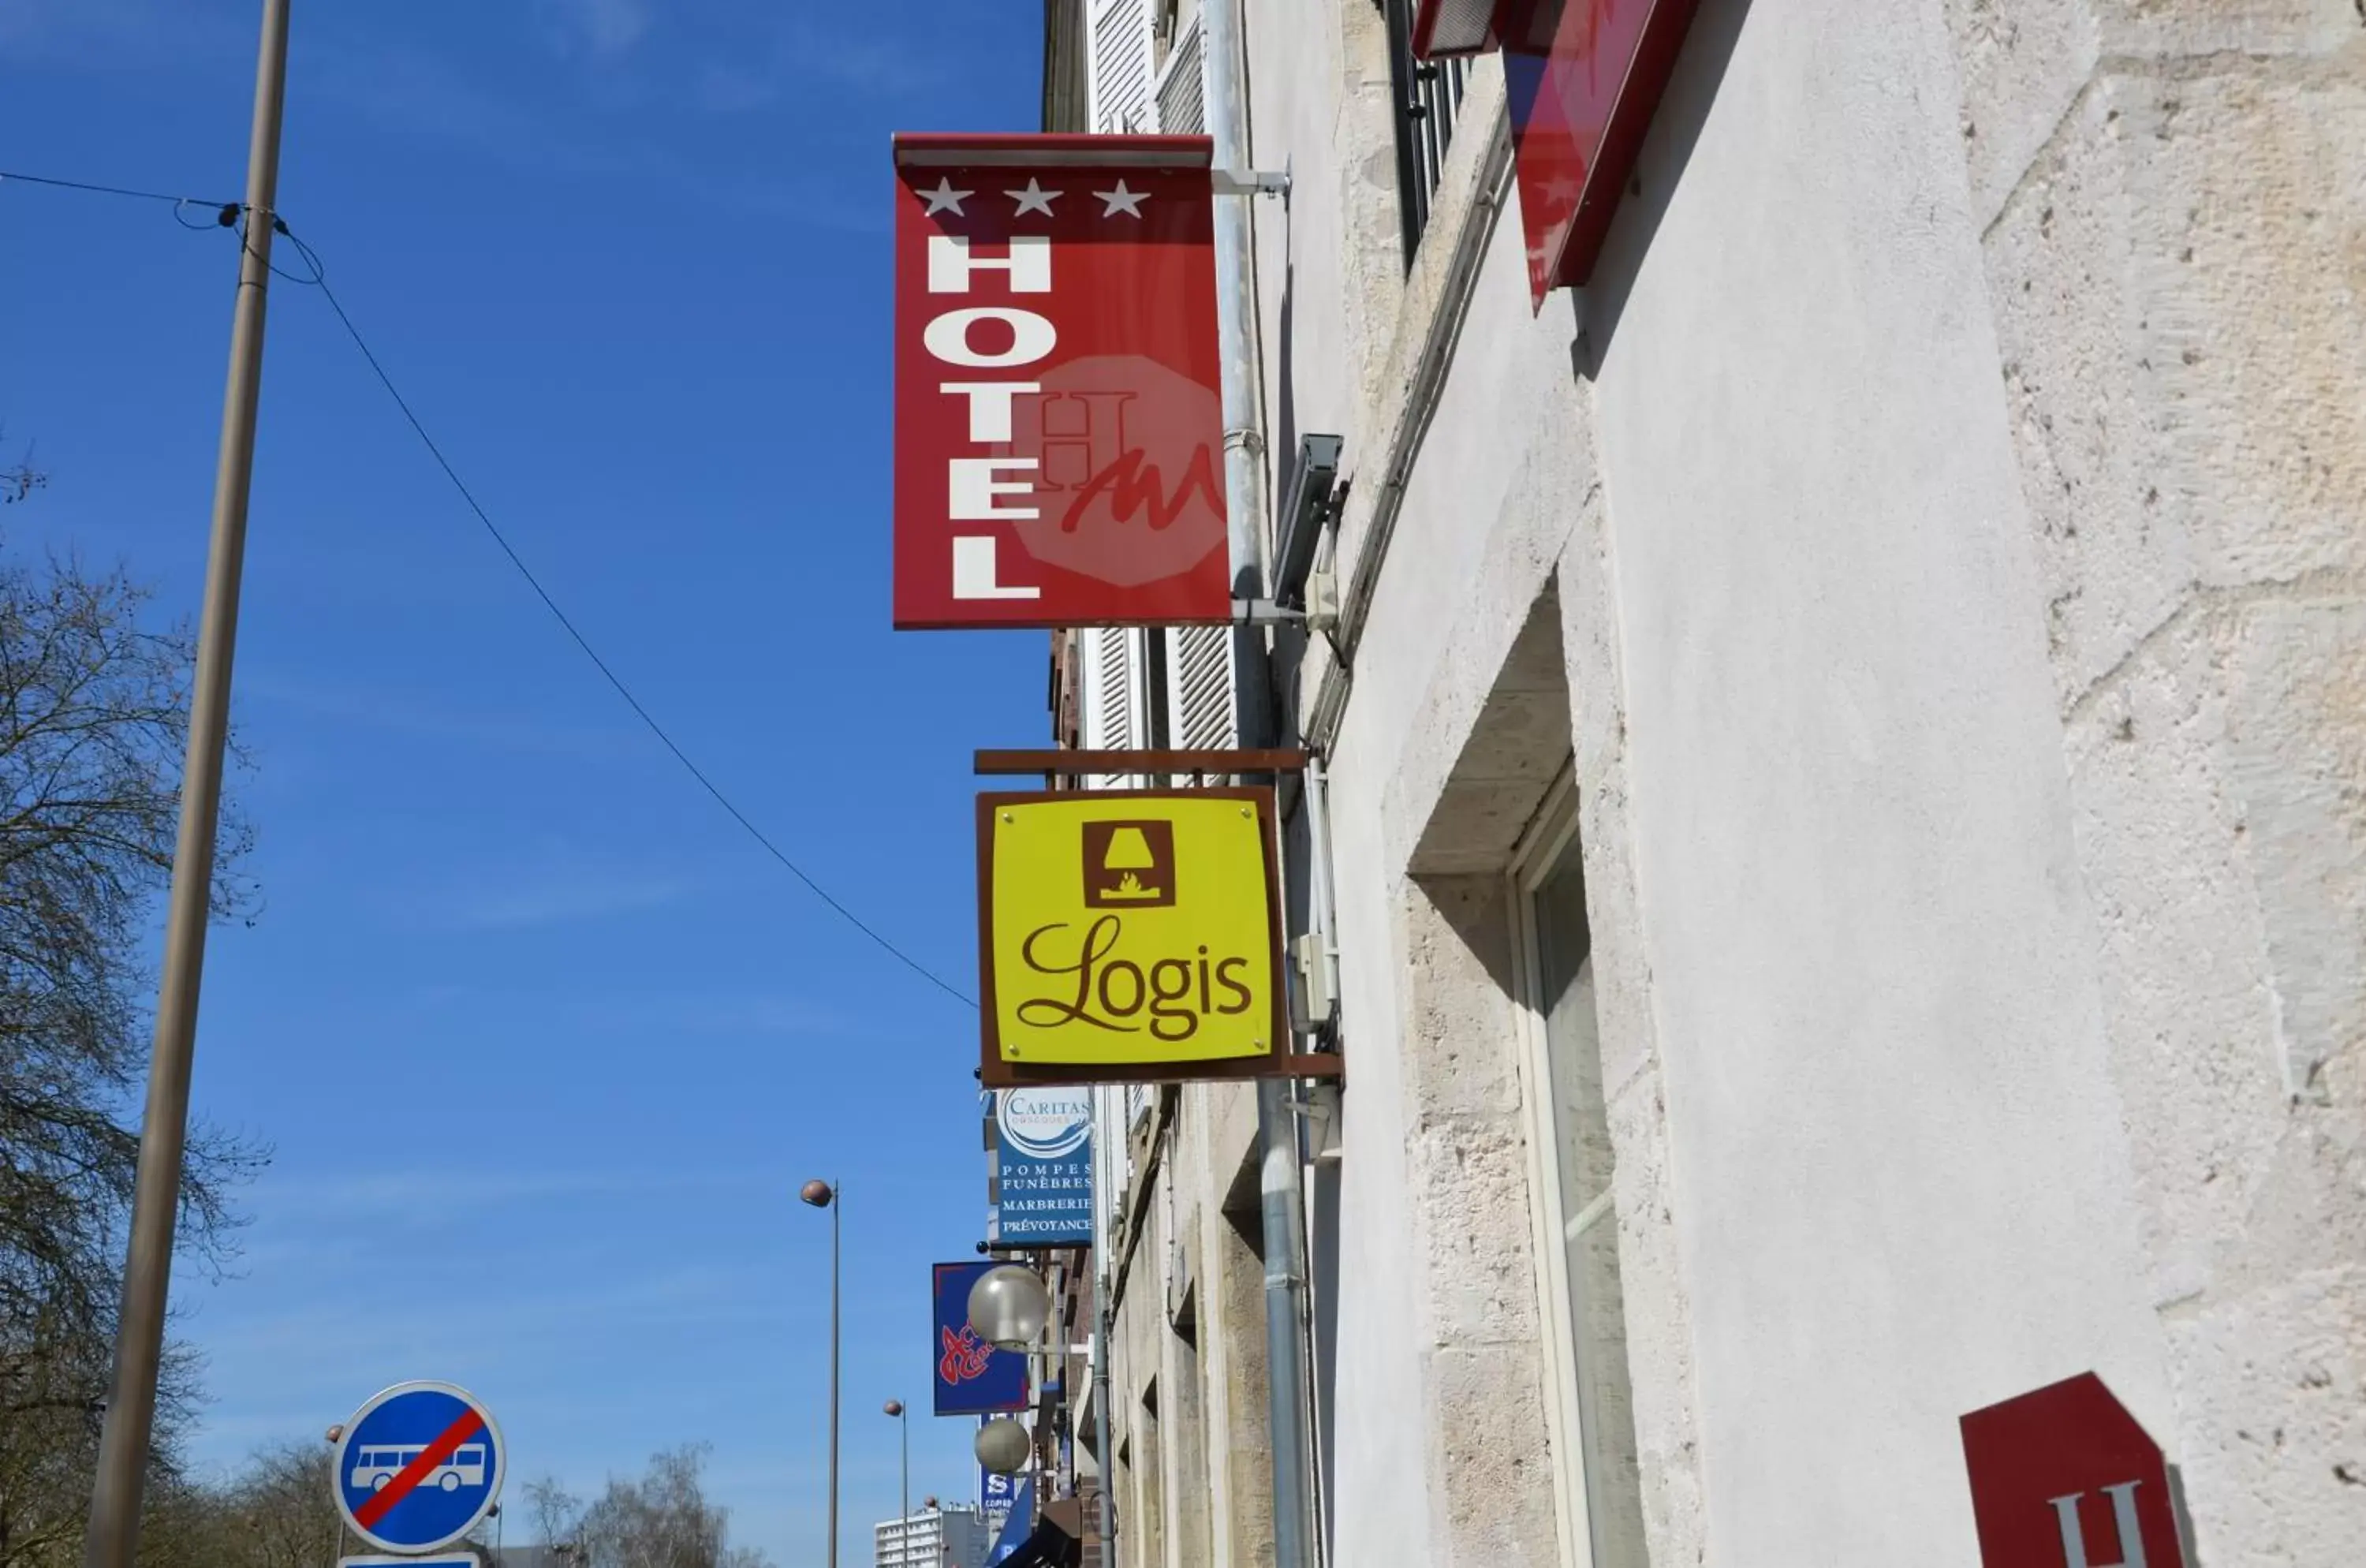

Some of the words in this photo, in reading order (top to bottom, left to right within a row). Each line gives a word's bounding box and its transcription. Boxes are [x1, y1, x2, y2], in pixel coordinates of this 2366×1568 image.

[924, 235, 1057, 599] HOTEL
[1017, 914, 1252, 1042] Logis
[1002, 1163, 1092, 1176] POMPES
[1002, 1176, 1092, 1189] FUNÈBRES
[1002, 1198, 1093, 1211] MARBRERIE
[1003, 1219, 1093, 1232] PRÉVOYANCE
